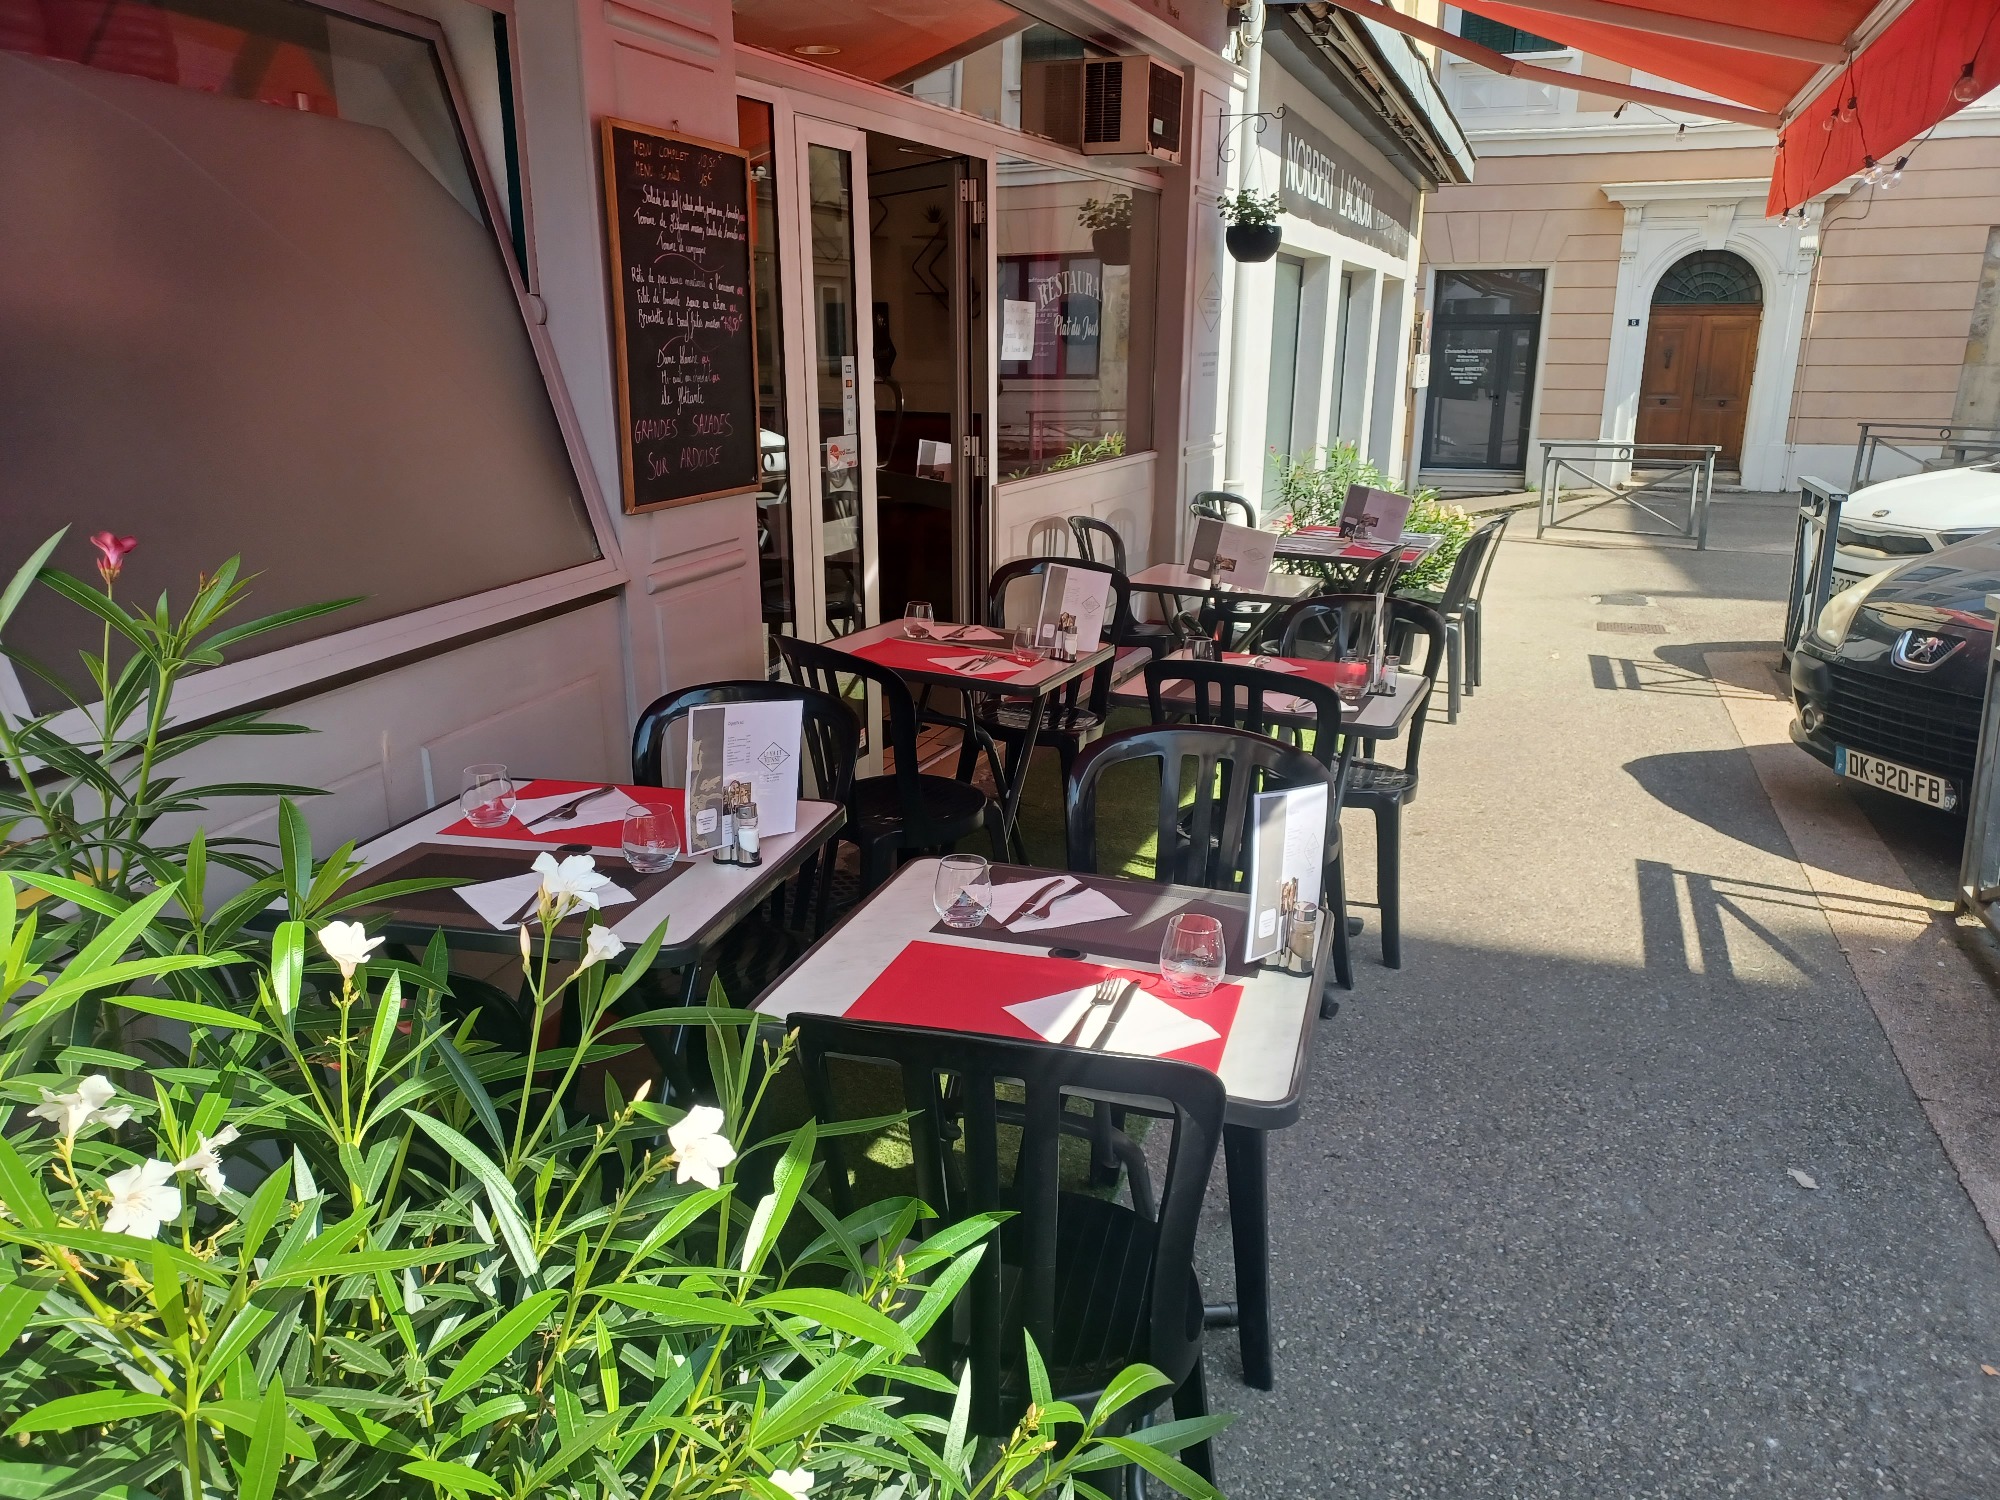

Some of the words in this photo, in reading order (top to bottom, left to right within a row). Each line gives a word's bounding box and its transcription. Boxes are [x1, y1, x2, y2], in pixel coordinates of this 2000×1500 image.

[1286, 132, 1336, 209] NORBERT
[1339, 169, 1374, 229] LACROIX
[1054, 315, 1073, 336] Plat
[1071, 316, 1080, 336] du
[635, 418, 679, 444] GRANDES
[690, 412, 734, 438] SALADES
[680, 445, 723, 472] ARDOISE
[1849, 752, 1941, 804] DK-920-FB
